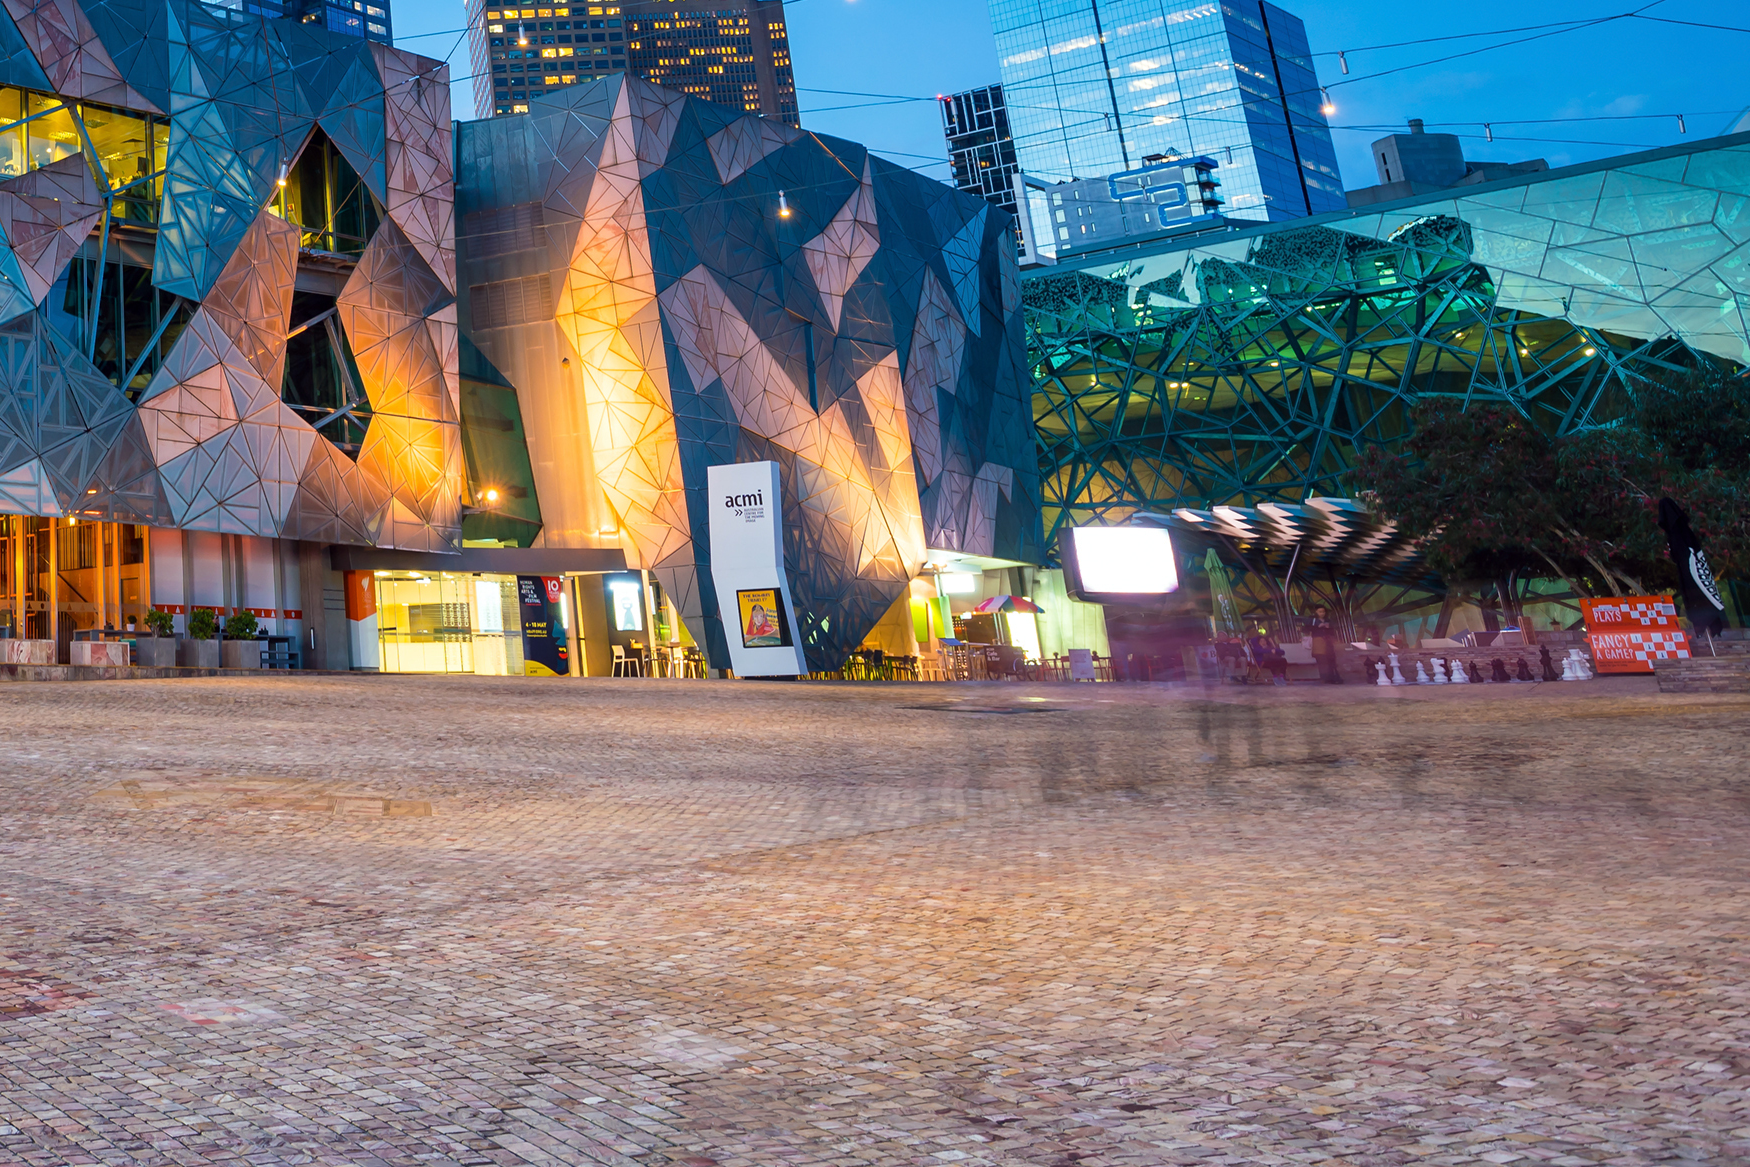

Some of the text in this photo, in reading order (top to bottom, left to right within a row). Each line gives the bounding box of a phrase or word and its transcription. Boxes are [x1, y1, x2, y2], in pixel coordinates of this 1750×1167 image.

[725, 489, 763, 508] acmi
[1593, 611, 1622, 623] PLAYS
[1591, 634, 1629, 649] FANCY
[1596, 648, 1634, 660] A GAME?
